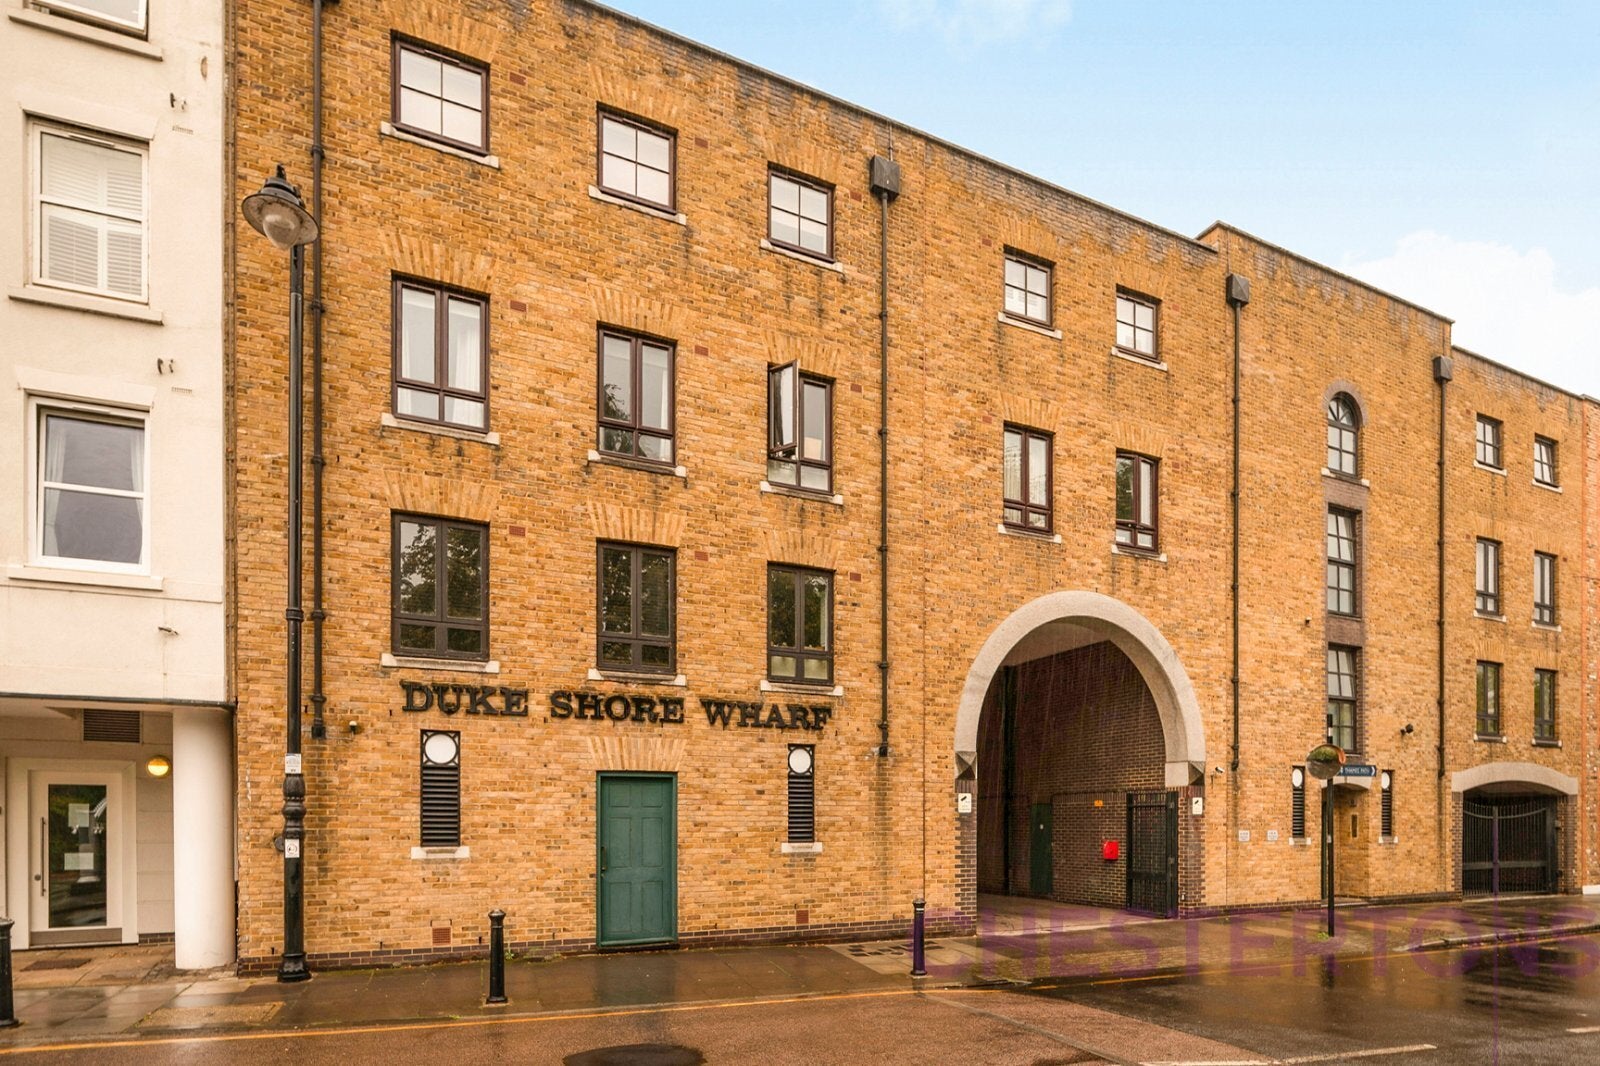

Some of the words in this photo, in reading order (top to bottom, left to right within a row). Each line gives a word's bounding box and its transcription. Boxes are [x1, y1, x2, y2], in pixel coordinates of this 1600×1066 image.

[400, 679, 529, 717] DUKE
[550, 689, 685, 724] SHORE
[699, 699, 832, 731] WHARF
